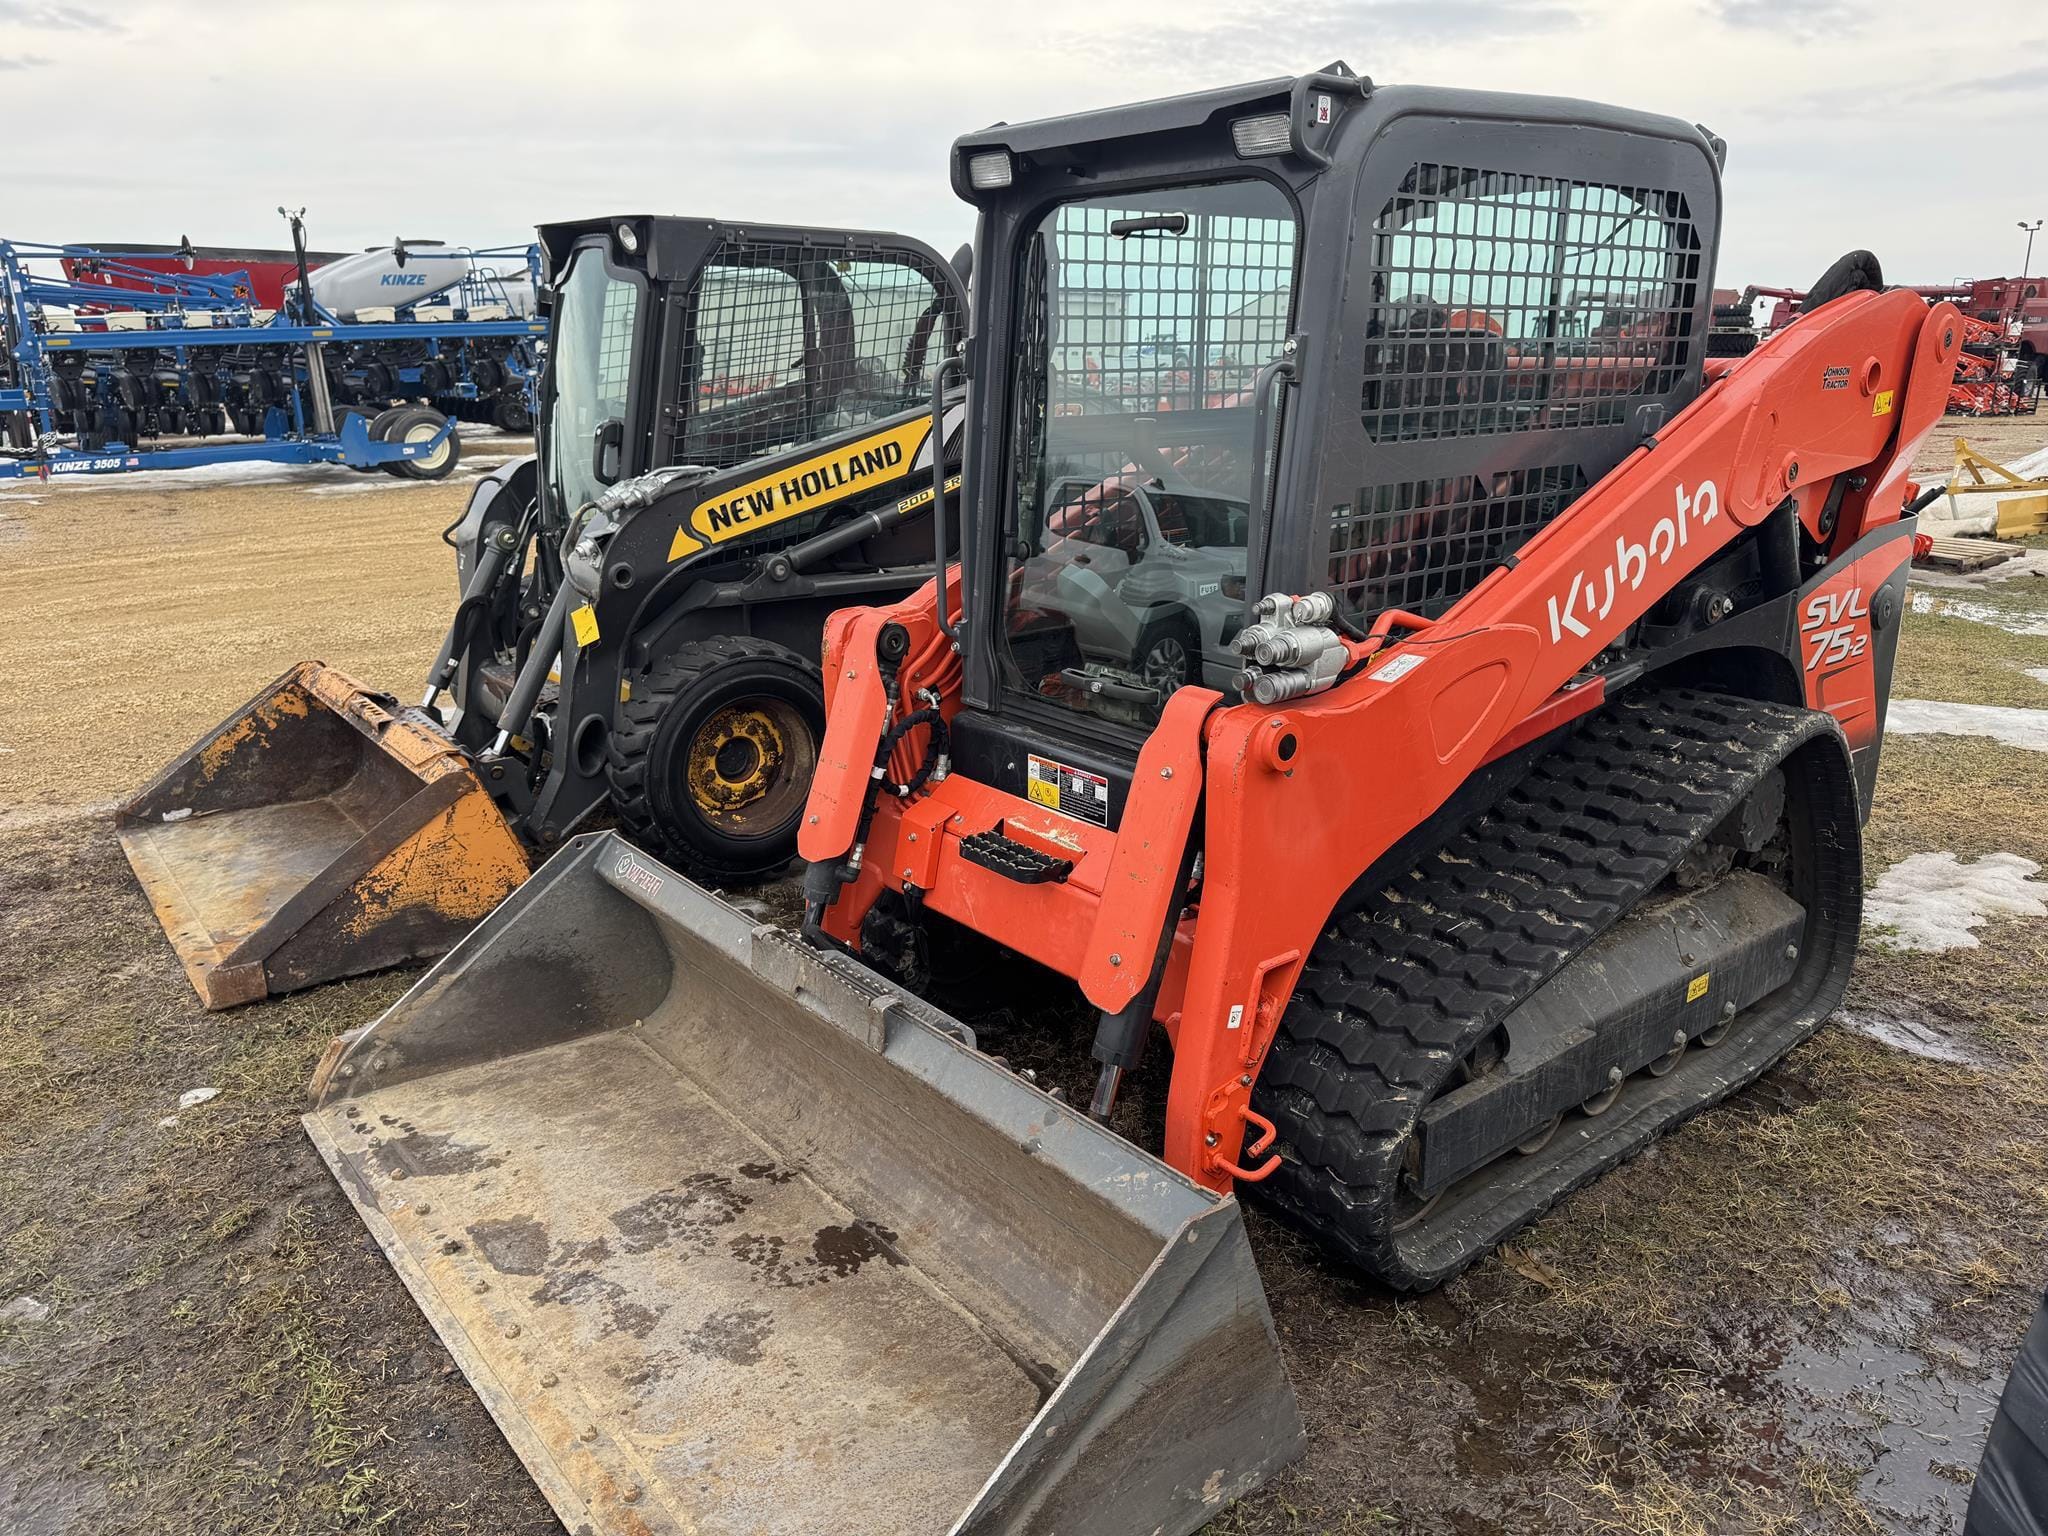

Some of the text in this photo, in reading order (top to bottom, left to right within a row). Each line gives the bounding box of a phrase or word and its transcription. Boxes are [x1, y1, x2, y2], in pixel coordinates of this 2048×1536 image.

[381, 274, 427, 286] KINZE
[1823, 365, 1851, 378] JOHNSON
[1822, 377, 1849, 390] TRACTOR
[52, 458, 122, 473] KINZE 3505
[706, 440, 903, 533] NEW HOLLAND
[899, 491, 929, 512] 200
[1547, 479, 1719, 645] Kubota
[1801, 587, 1868, 632] SVL
